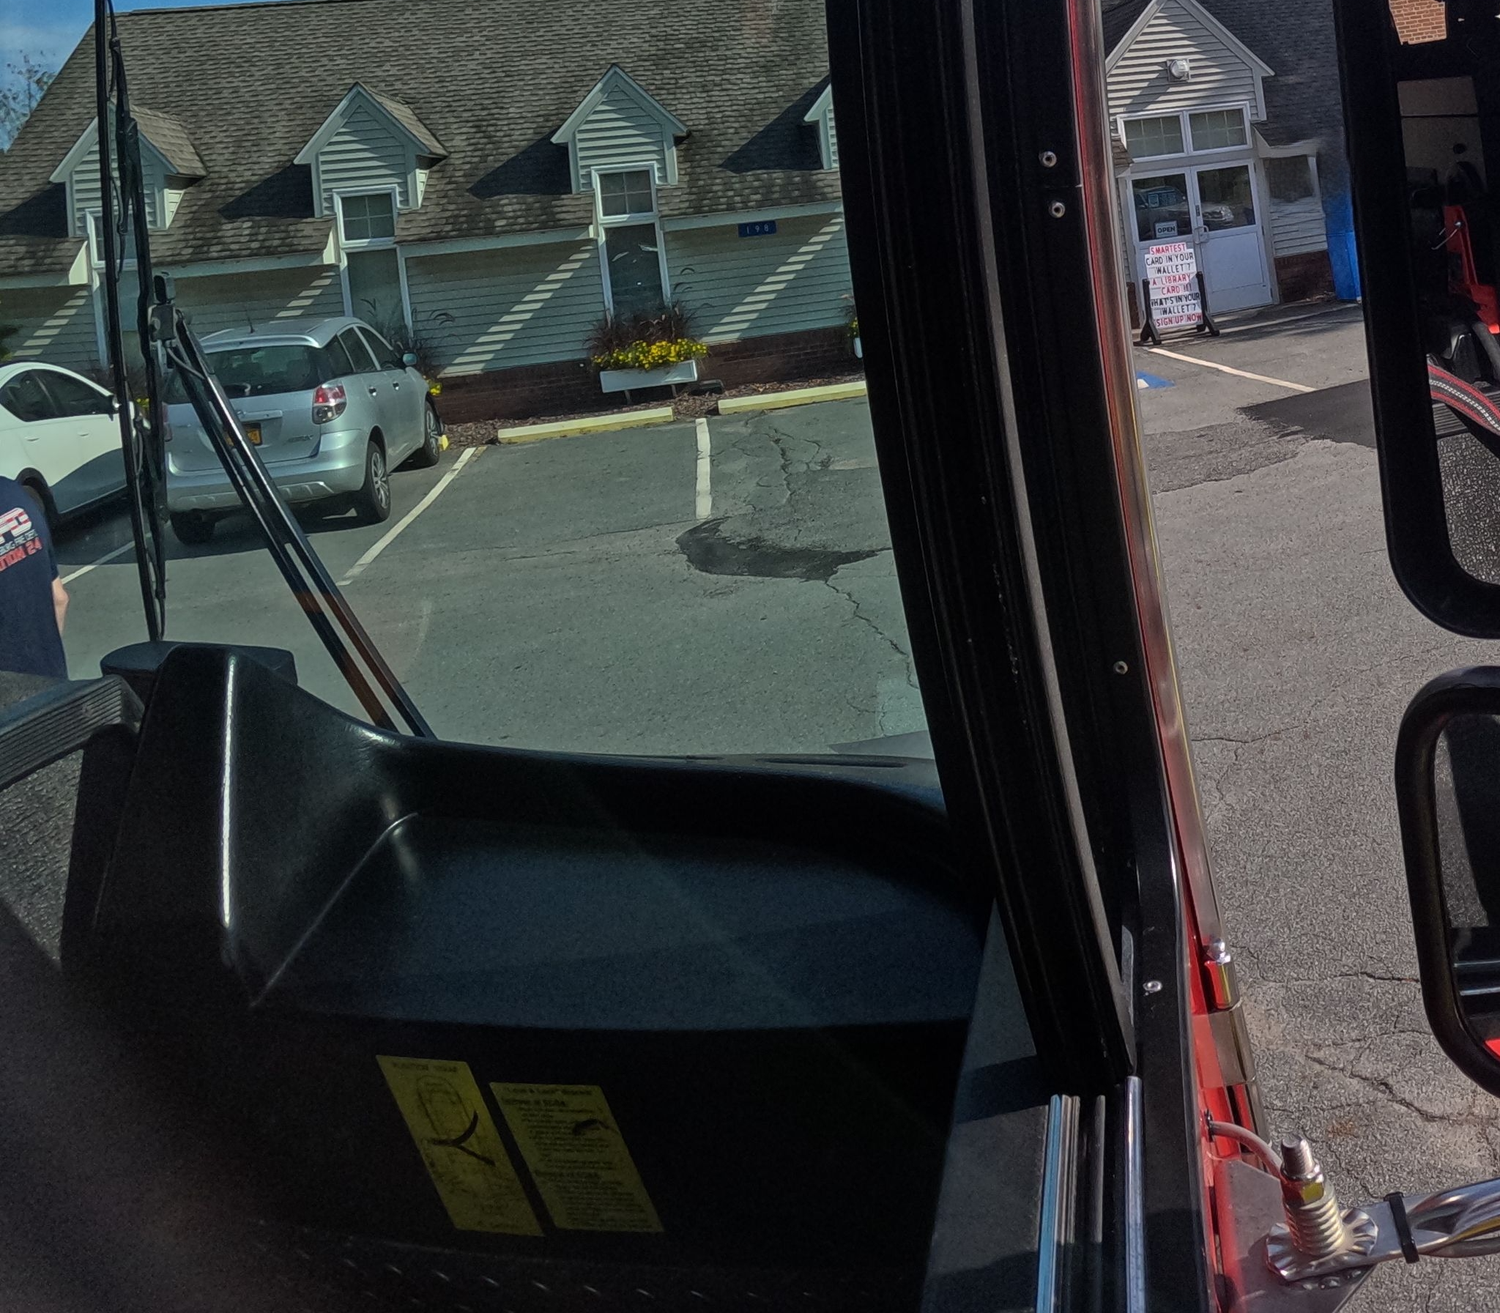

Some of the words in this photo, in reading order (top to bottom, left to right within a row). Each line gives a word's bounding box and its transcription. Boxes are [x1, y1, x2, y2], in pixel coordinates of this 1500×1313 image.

[1151, 244, 1186, 255] SMARTEST
[1146, 256, 1164, 266] CARD
[1165, 254, 1173, 263] IN
[1175, 252, 1195, 262] YOUR
[1156, 263, 1184, 274] WALLET
[1161, 274, 1191, 286] LIBRARY
[1161, 285, 1181, 295] CARD
[1175, 295, 1183, 304] IN
[1184, 292, 1201, 301] YOUR
[1162, 305, 1190, 315] WALLET
[1156, 318, 1174, 327] SIGN
[1175, 316, 1184, 324] UP
[1186, 313, 1202, 323] NOW
